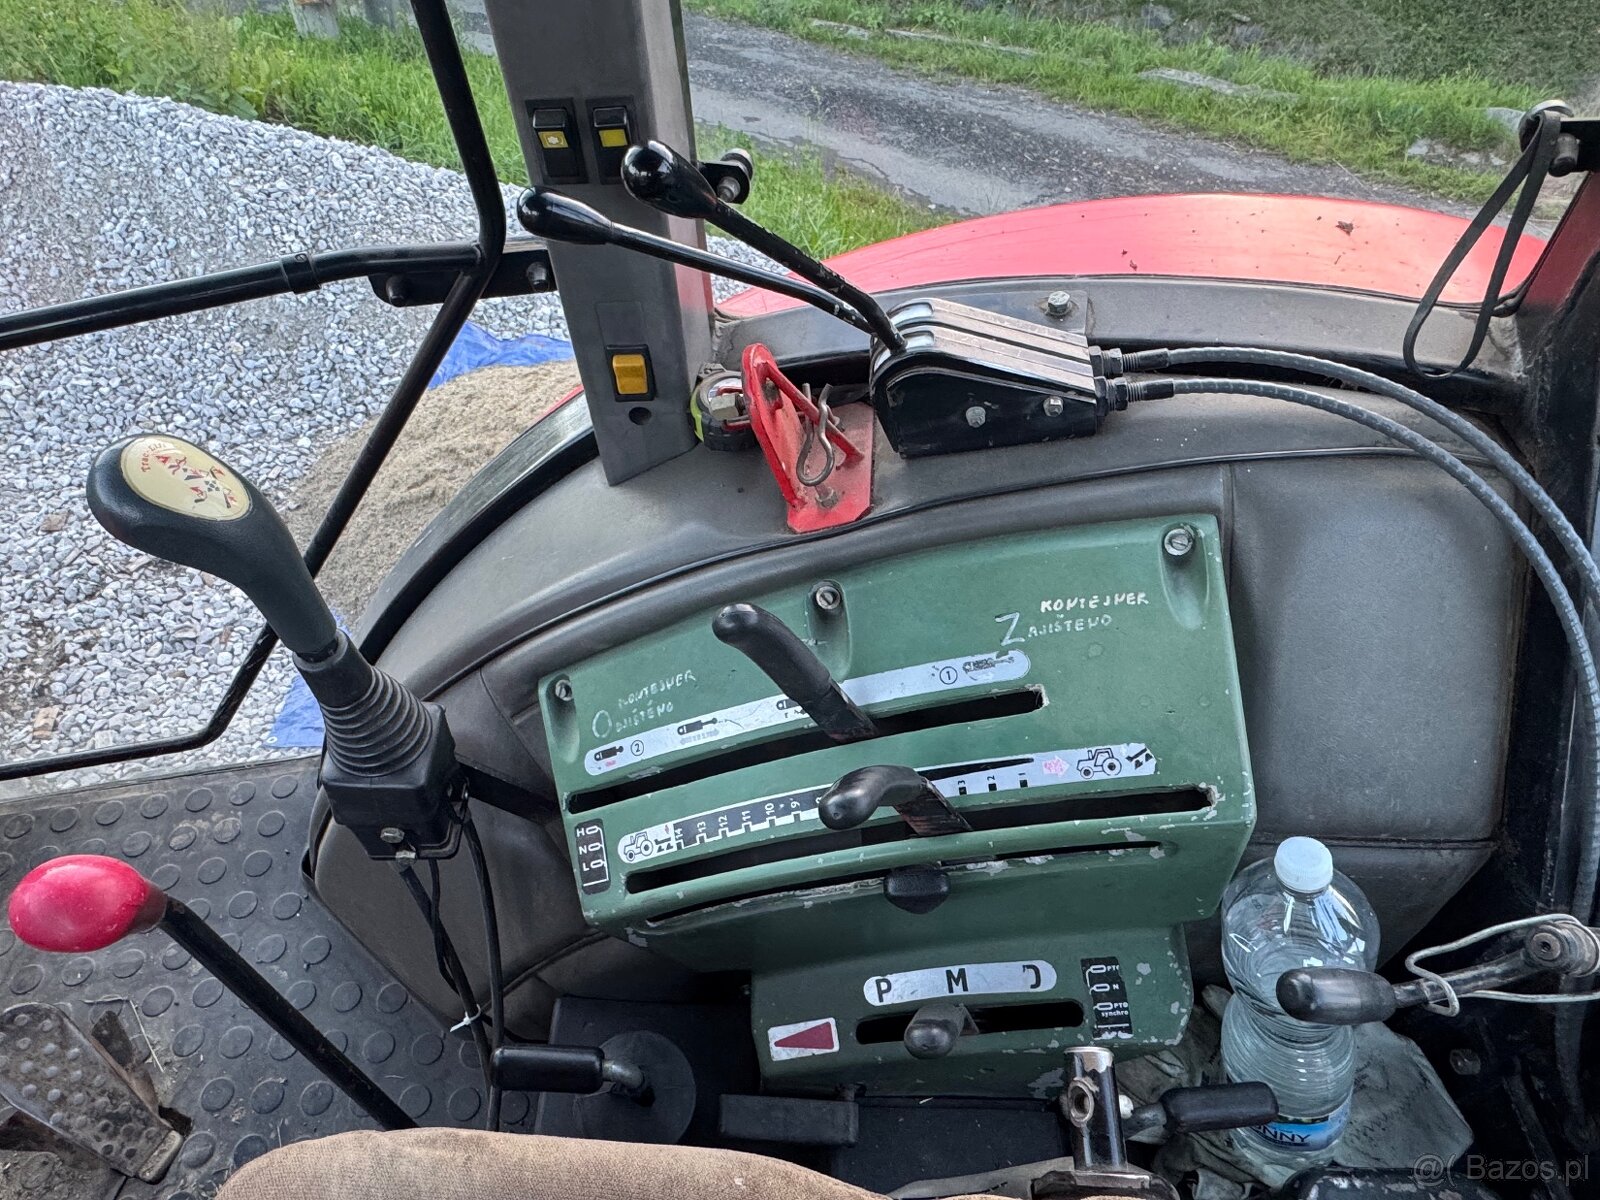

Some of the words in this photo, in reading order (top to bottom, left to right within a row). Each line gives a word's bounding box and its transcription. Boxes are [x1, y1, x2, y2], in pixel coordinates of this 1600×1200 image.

[675, 827, 683, 840] 14
[697, 821, 706, 833] 13
[718, 814, 728, 827] 12
[741, 810, 751, 822] 11
[764, 802, 775, 816] 10
[790, 801, 800, 809] 9
[576, 827, 585, 837] H
[578, 845, 588, 855] N
[582, 862, 590, 872] L
[875, 978, 893, 1003] P
[945, 967, 969, 994] M
[1113, 1001, 1129, 1009] PTO
[1101, 1009, 1129, 1018] synchro
